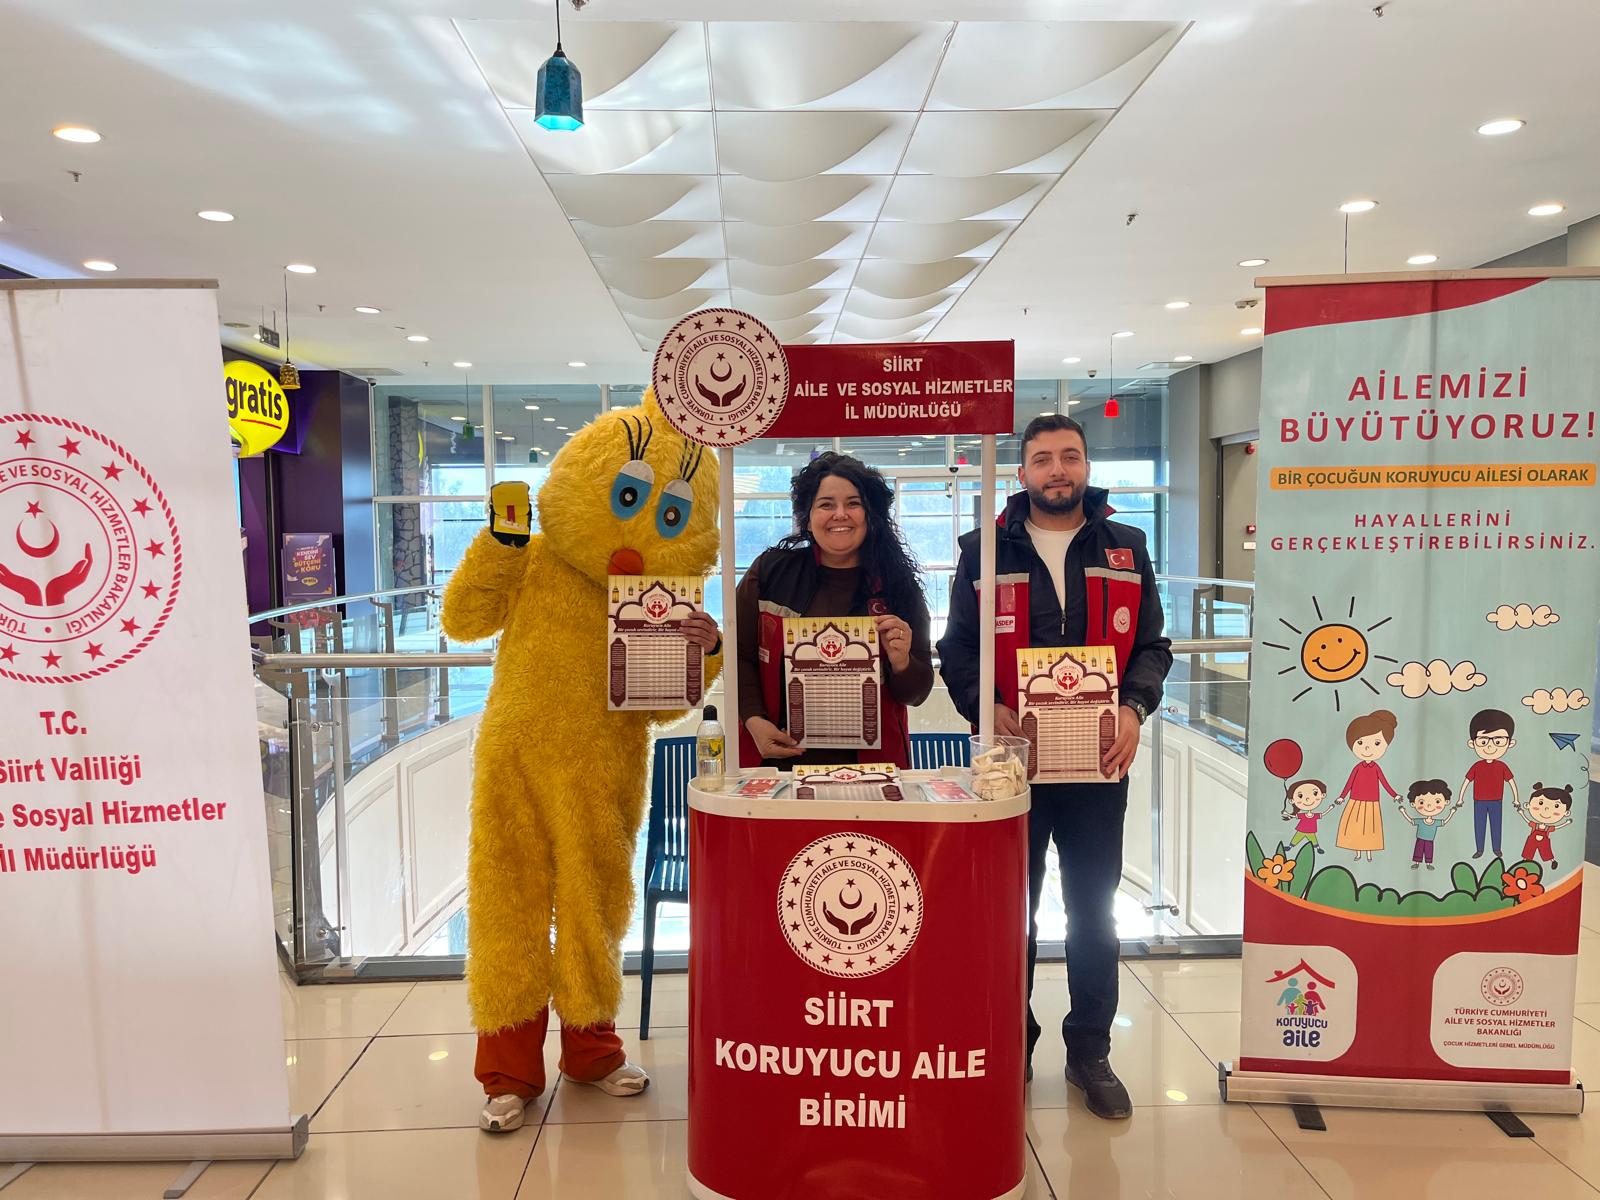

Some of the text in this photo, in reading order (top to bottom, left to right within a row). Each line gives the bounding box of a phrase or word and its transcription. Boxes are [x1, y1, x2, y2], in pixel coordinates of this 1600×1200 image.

[693, 336, 708, 348] AİLE
[720, 334, 746, 350] SOSYAL
[678, 347, 695, 399] CUMHURİYETİ
[746, 348, 763, 390] HİZMETLER
[882, 355, 923, 372] SİİRT
[794, 378, 1013, 397] AİLE VE SOSYAL HİZMETLER
[1348, 366, 1527, 401] AİLEMİZİ
[226, 376, 283, 421] gratis
[687, 398, 714, 421] TÜRKİYE
[728, 390, 761, 421] BAKANLIĞI
[845, 401, 962, 419] İL MÜDÜRLÜĞÜ
[1280, 408, 1595, 443] BÜYÜTÜYORUZ!
[1278, 467, 1589, 487] BİR ÇOCUĞUN KORUYUCU AİLESİ OLARAK
[1354, 509, 1510, 528] HAYALLERİNİ
[8, 464, 131, 634] VE SOSYAL HİZMETLER BAKANLIĞI
[1270, 532, 1595, 554] GERÇEKLEŞTİREBİLİRSİNİZ.
[40, 710, 88, 735] T.C.
[50, 755, 142, 786] Valiliği
[12, 802, 94, 832] Sosyal
[102, 797, 227, 825] Hizmetler
[24, 844, 157, 875] Müdürlüğü
[821, 862, 837, 873] AİLE
[850, 860, 879, 877] SOSYAL
[804, 872, 822, 927] CUMHURİYETİ
[879, 874, 896, 919] HİZMETLER
[812, 925, 842, 950] TÜRKİYE
[856, 921, 892, 950] BAKANLIĞI
[804, 991, 894, 1028] SİİRT
[1444, 1016, 1463, 1025] AİLE
[1476, 1018, 1508, 1026] SOSYAL
[1509, 1019, 1556, 1028] HİZMETLER
[1454, 1007, 1548, 1018] TÜRKİYE CUMHURİYETİ
[1283, 1029, 1321, 1047] aile
[1476, 1028, 1522, 1036] BAKANLIĞI
[714, 1037, 986, 1079] KORUYUCU AİLE
[799, 1092, 906, 1129] BİRİMİ
